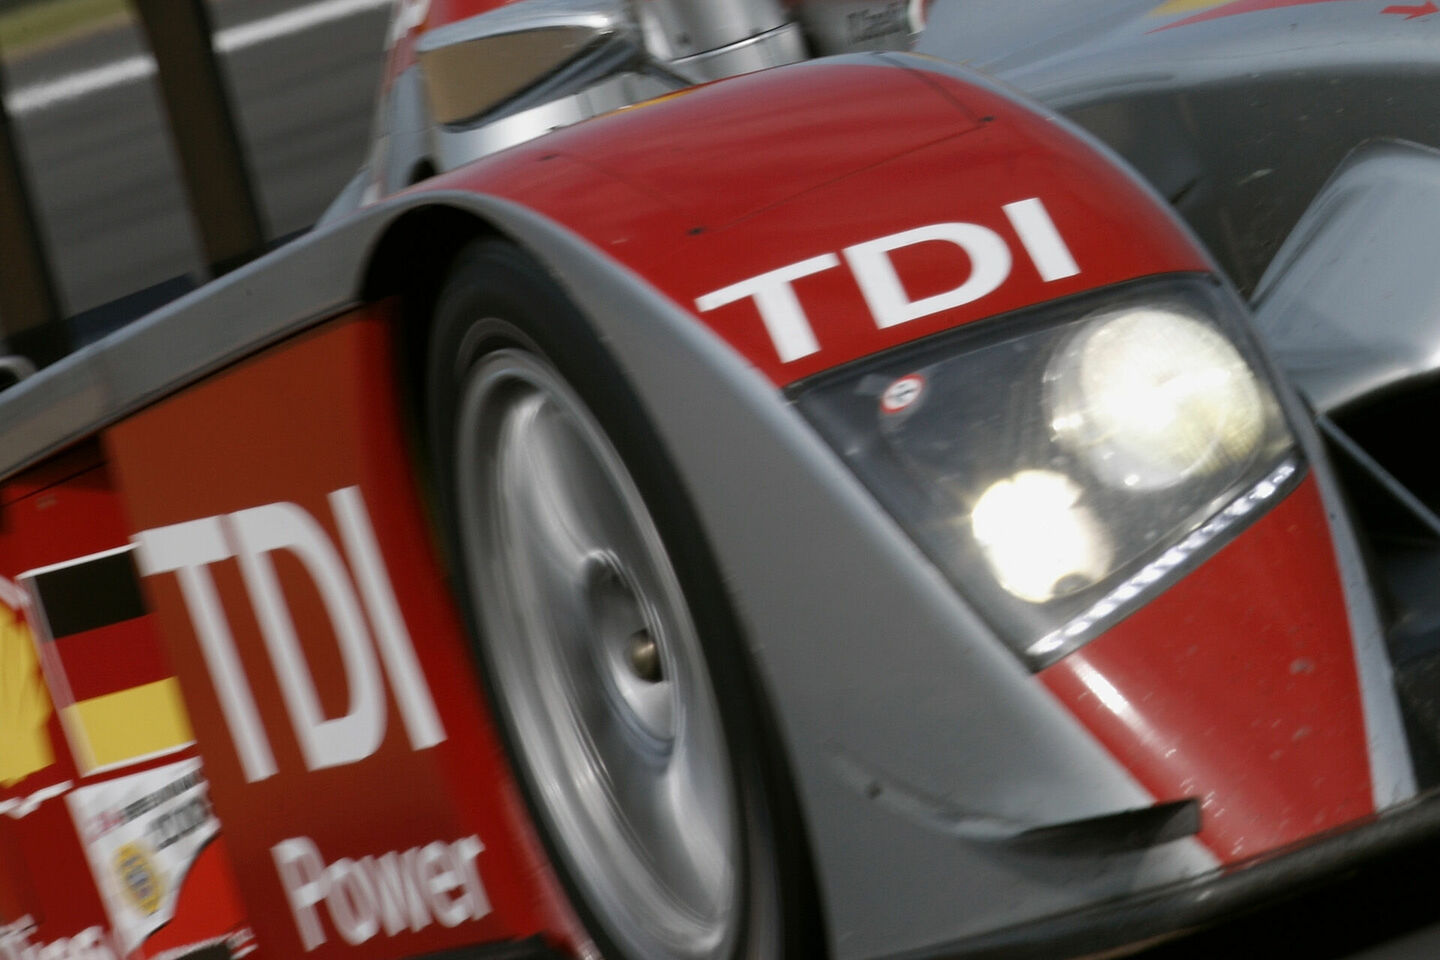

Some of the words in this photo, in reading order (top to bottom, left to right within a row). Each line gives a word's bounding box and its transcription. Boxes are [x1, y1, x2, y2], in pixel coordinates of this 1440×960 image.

[695, 197, 1081, 364] TDI
[130, 485, 447, 783] TDI
[270, 834, 492, 952] Power
